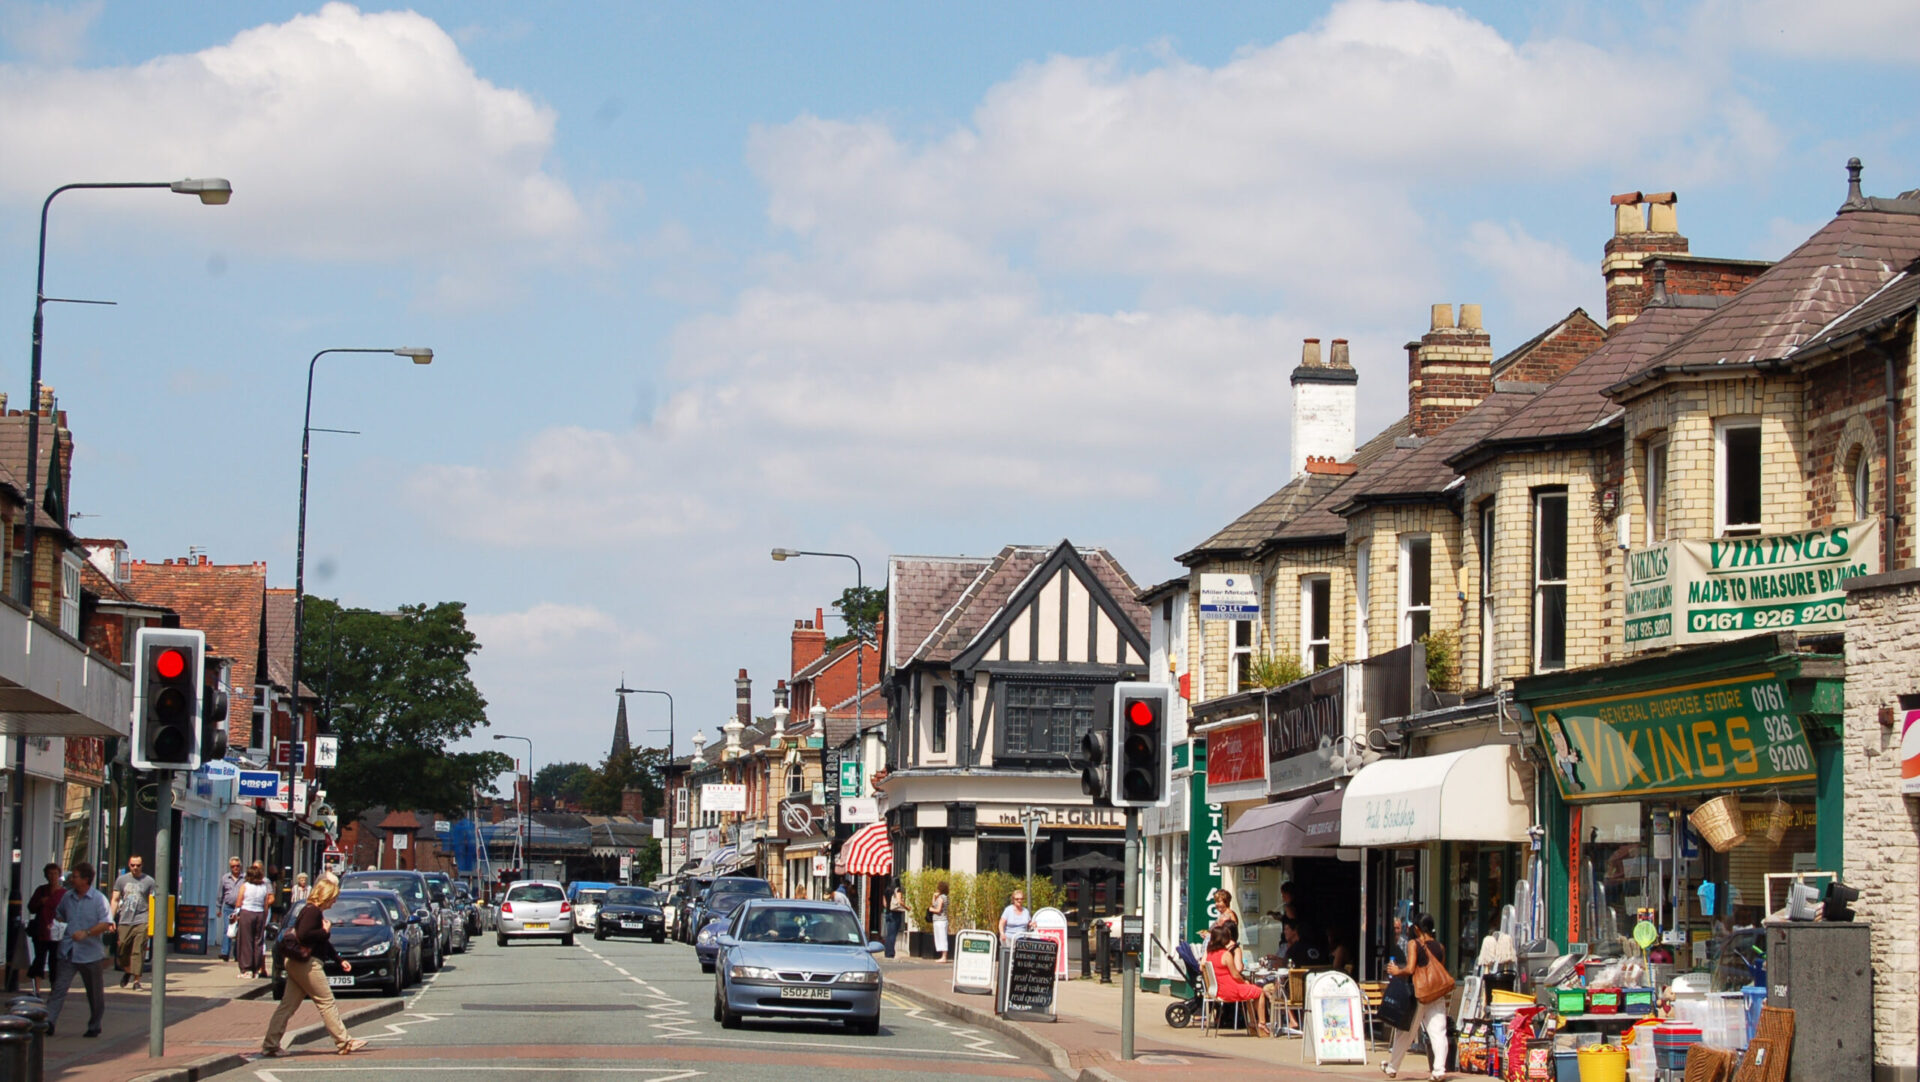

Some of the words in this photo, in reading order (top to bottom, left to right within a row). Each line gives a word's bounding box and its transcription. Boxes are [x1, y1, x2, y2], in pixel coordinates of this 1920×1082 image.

[1709, 526, 1848, 570] VIKINGS
[1630, 546, 1669, 582] VIKINGS
[1688, 579, 1728, 604] MADE
[1730, 577, 1747, 602] TO
[1750, 570, 1817, 600] MEASURE
[1216, 604, 1227, 612] TO
[1692, 611, 1744, 632] 0161
[1753, 607, 1796, 629] 926
[1800, 602, 1847, 623] 920
[1599, 704, 1649, 725] GENERAL
[1650, 695, 1703, 719] PURPOSE
[1704, 688, 1743, 713] STORE
[1751, 682, 1786, 713] 0161
[1763, 713, 1794, 743] 926
[1570, 715, 1759, 787] VIKINGS
[1768, 743, 1810, 772] 9200
[240, 779, 273, 789] omega
[999, 814, 1016, 825] the
[1067, 807, 1120, 826] GRILL
[1206, 802, 1223, 877] STATE
[782, 987, 809, 997] S502
[810, 988, 830, 999] ARE
